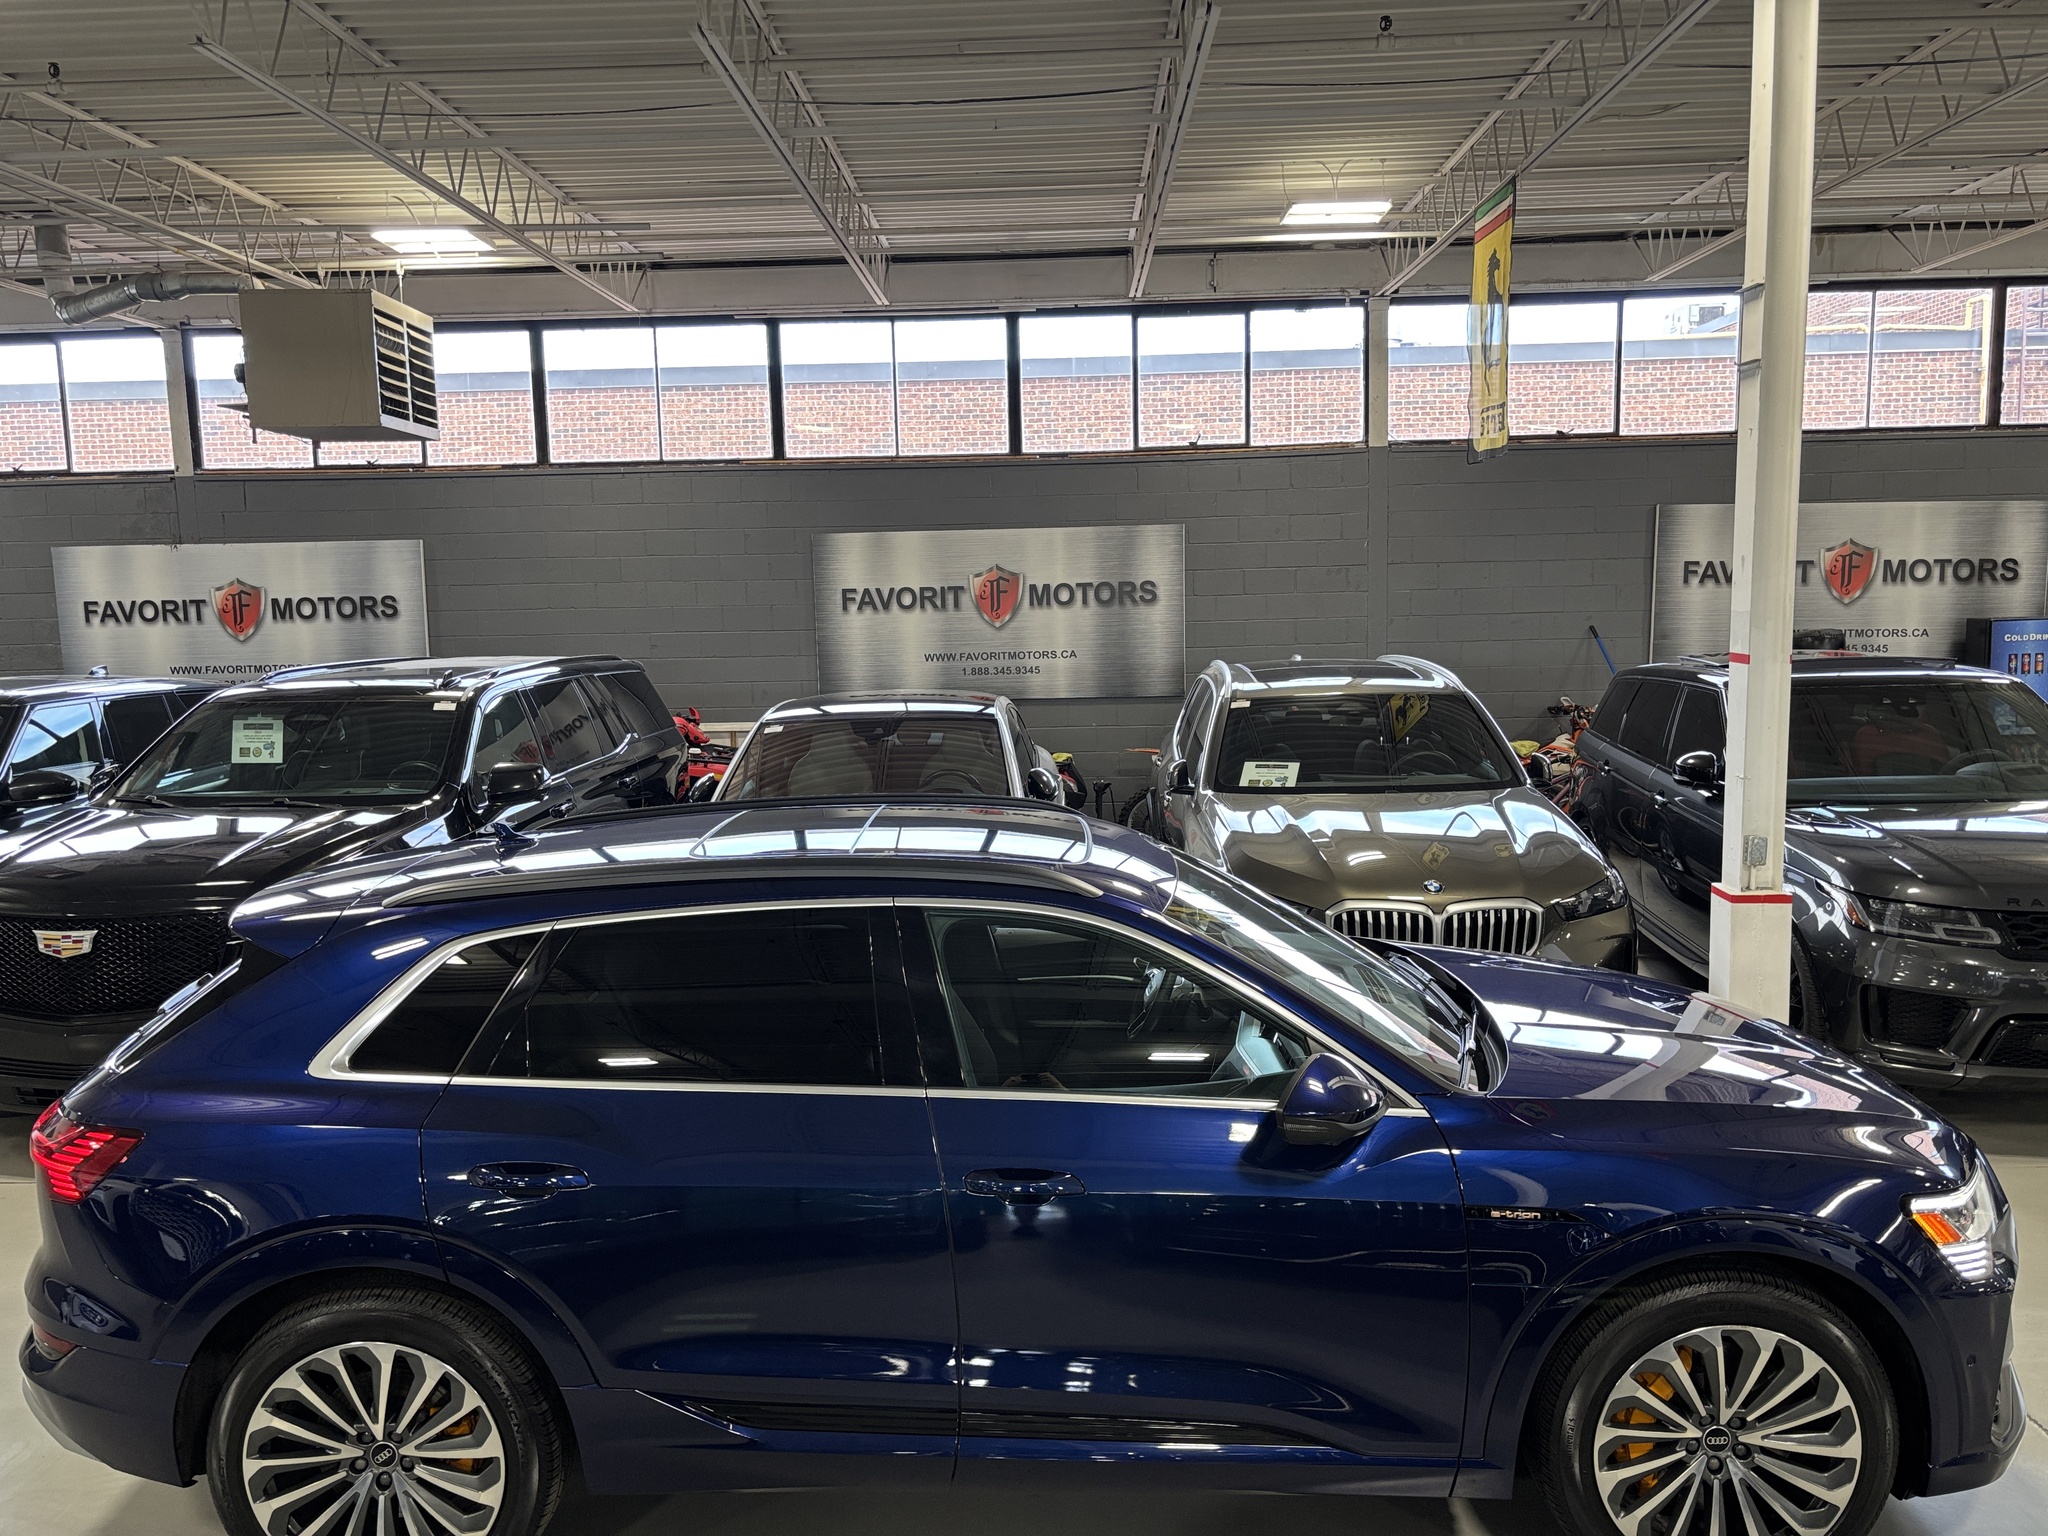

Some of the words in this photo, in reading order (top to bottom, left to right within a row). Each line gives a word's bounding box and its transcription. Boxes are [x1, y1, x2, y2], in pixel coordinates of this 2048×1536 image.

[1683, 559, 1815, 584] FAVT
[1882, 557, 2020, 583] MOTORS
[83, 599, 207, 623] FAVORIT
[270, 595, 399, 620] MOTORS
[841, 586, 965, 611] FAVORIT
[1028, 580, 1158, 606] MOTORS
[924, 650, 1078, 663] WWW.FAVORITMOTORS.CA
[961, 666, 1041, 676] 1.888.345.9345
